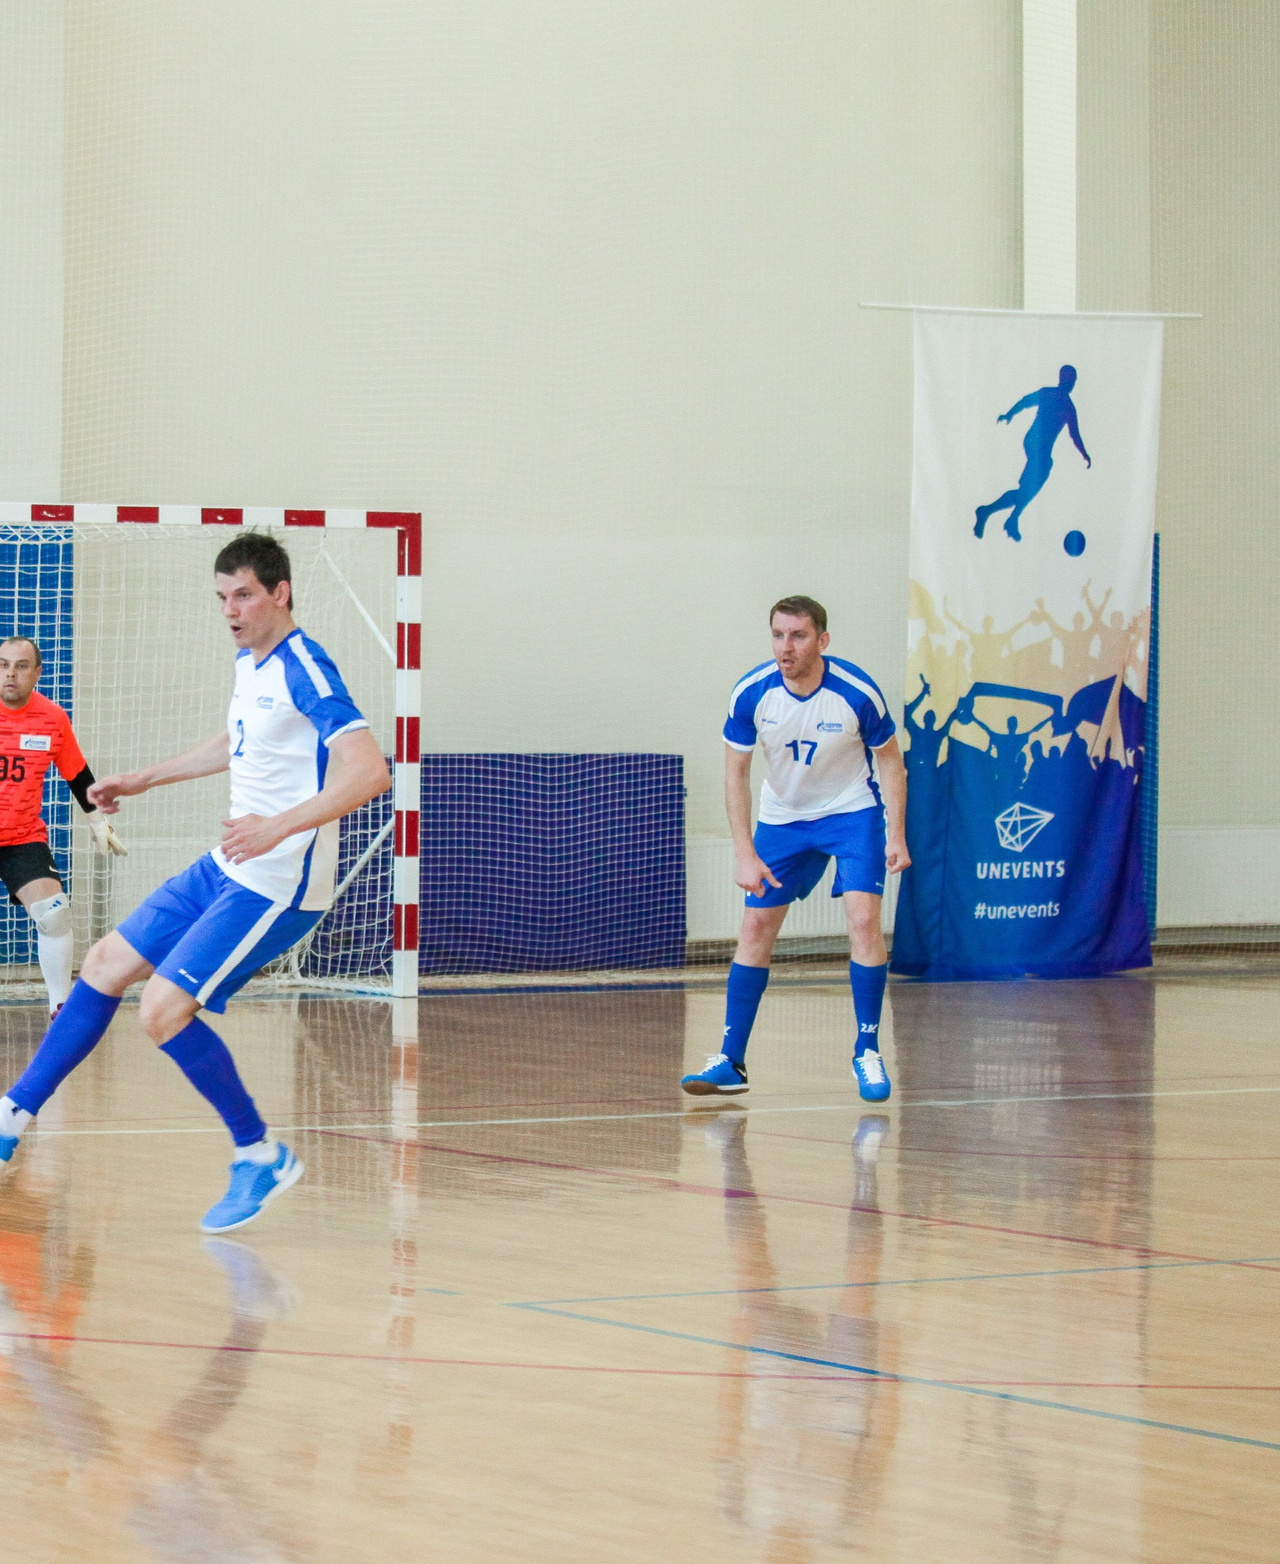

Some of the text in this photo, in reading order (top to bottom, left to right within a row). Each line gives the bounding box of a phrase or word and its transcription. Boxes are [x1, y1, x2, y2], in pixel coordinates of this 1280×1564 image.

[785, 740, 818, 766] 17
[976, 860, 1065, 880] UNEVENTS
[974, 901, 1060, 920] #unevents
